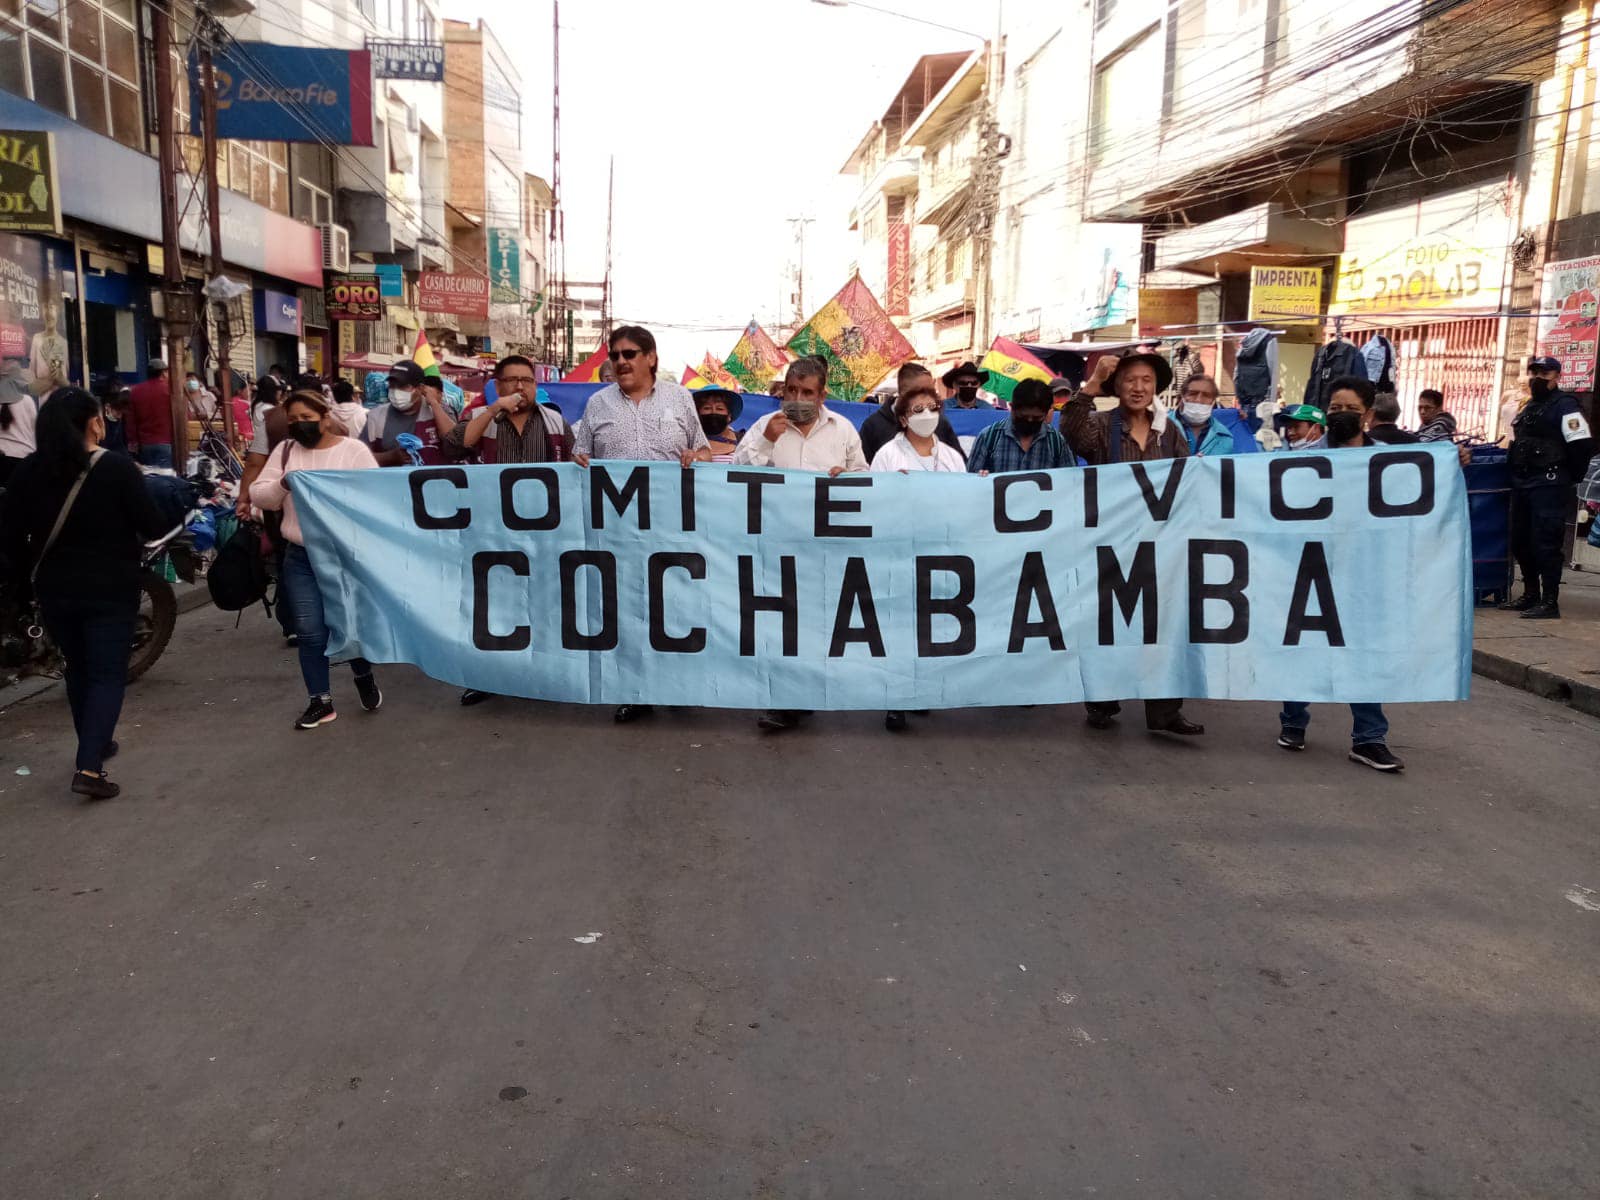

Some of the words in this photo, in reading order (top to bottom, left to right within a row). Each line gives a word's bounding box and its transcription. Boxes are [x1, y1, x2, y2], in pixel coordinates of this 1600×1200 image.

[1406, 243, 1449, 266] FOTO
[424, 274, 444, 291] CASA
[445, 276, 456, 292] DE
[456, 277, 485, 295] CAMBIO
[1255, 269, 1317, 287] IMPRENTA
[334, 285, 379, 303] ORO
[408, 465, 874, 538] COMITE
[992, 451, 1436, 534] CIVICO
[471, 538, 1347, 658] COCHABAMBA
